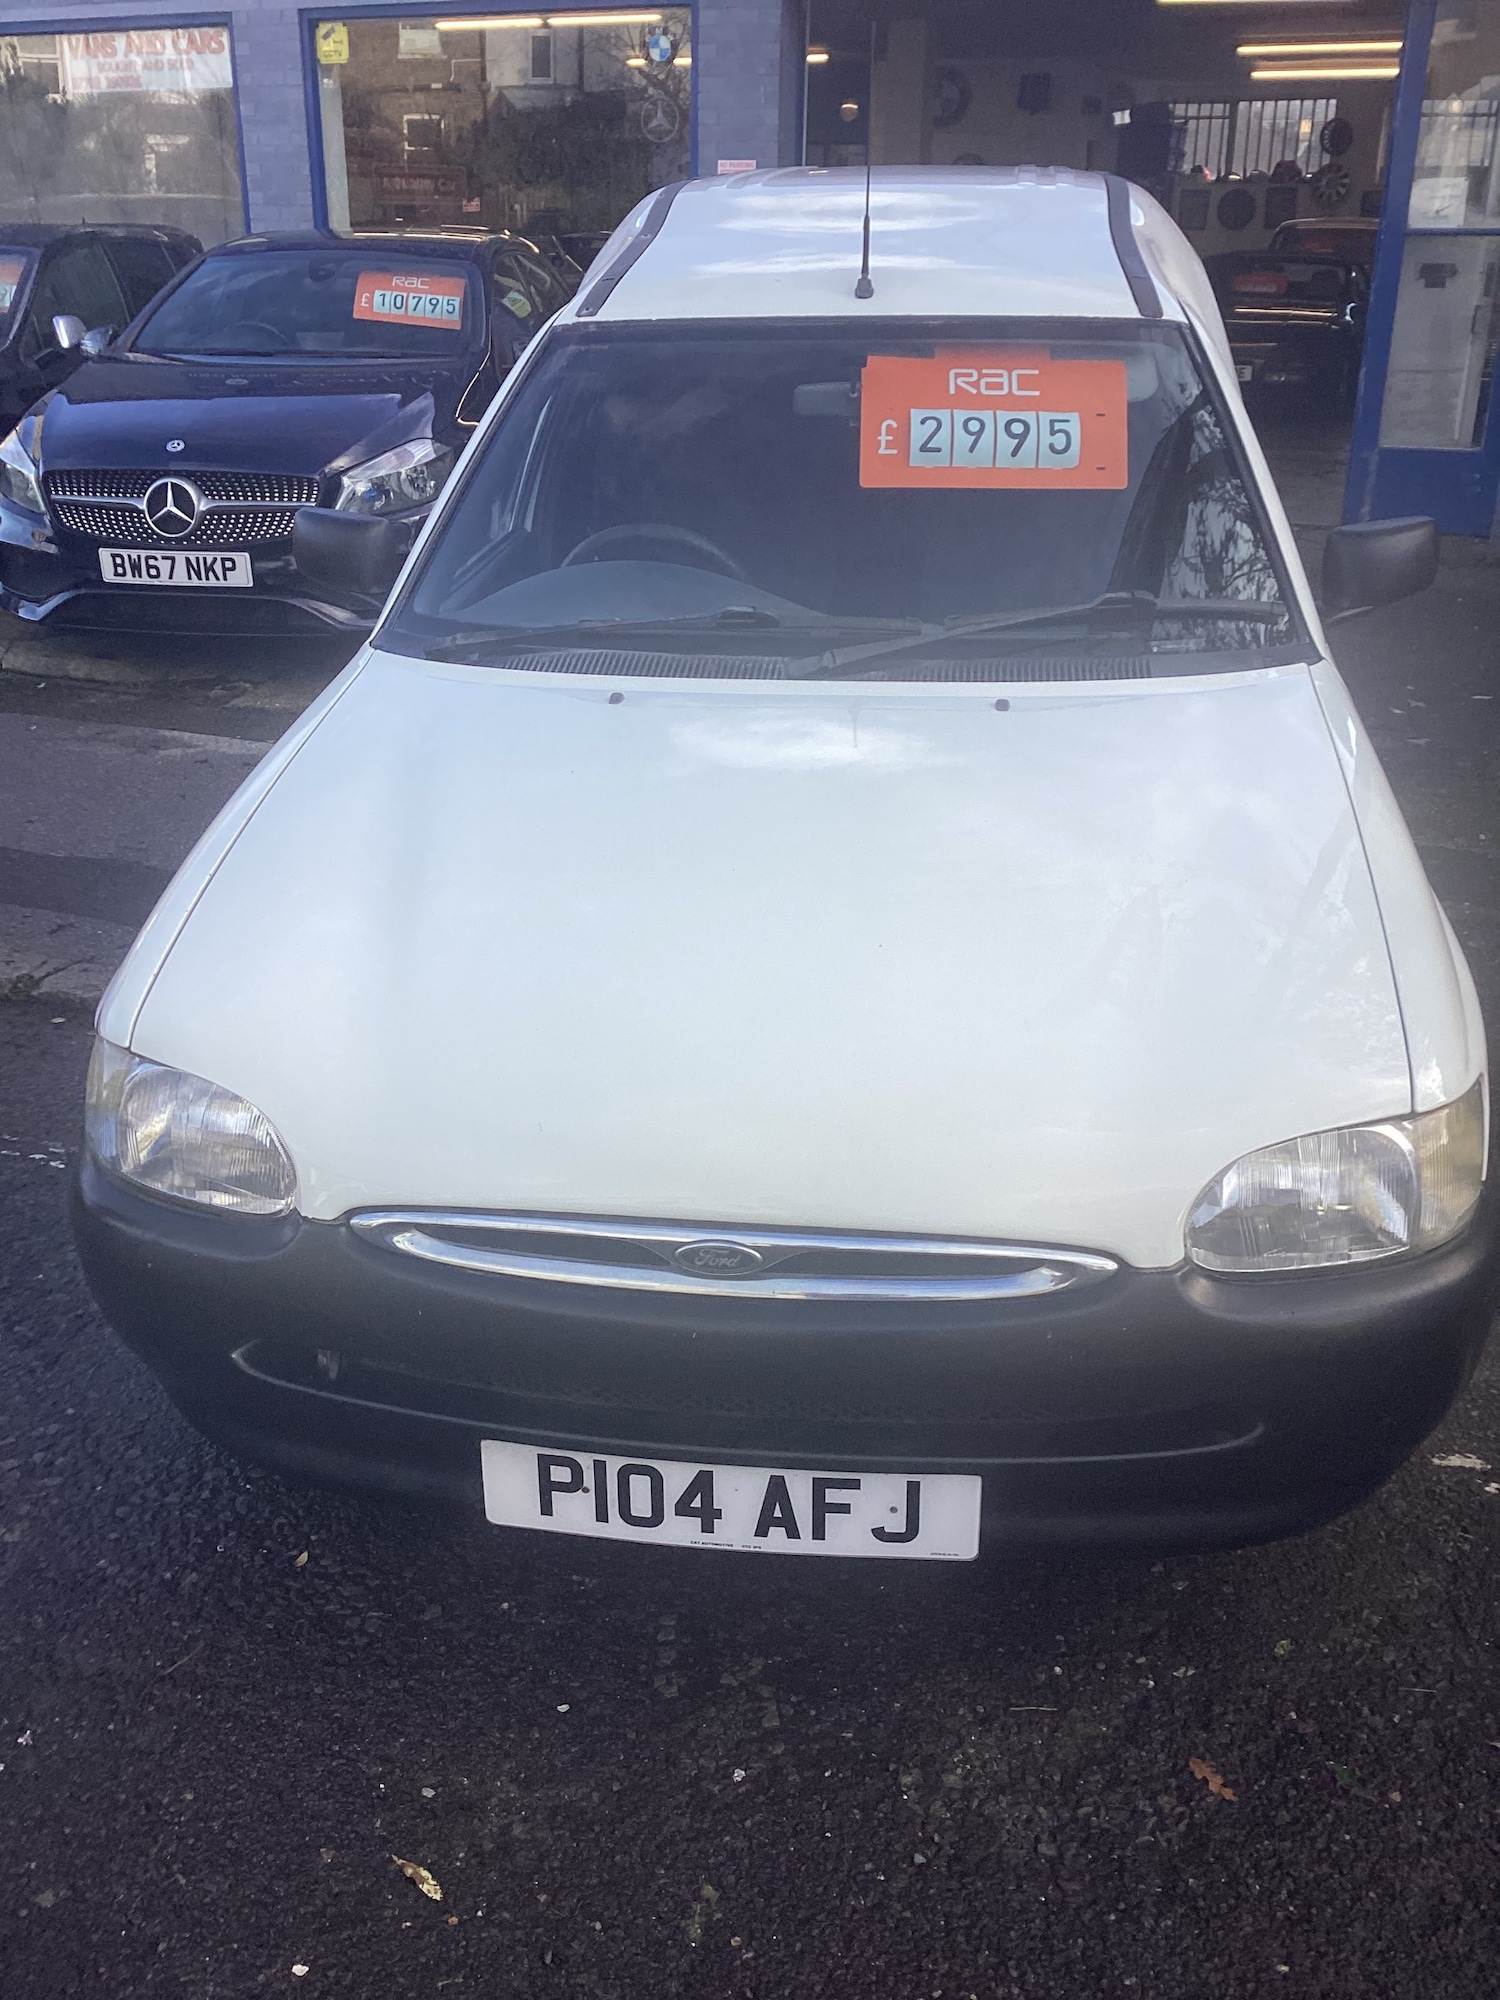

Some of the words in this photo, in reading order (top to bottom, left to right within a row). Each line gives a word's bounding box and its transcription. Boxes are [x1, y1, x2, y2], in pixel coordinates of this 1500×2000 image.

[68, 35, 118, 58] VANS
[125, 31, 166, 56] AND
[172, 29, 225, 55] CARS
[323, 50, 343, 58] CCTV
[110, 553, 176, 580] BW67
[185, 556, 237, 582] NKP
[694, 1248, 741, 1267] Ford
[536, 1453, 722, 1534] P104
[754, 1474, 921, 1544] AFJ
